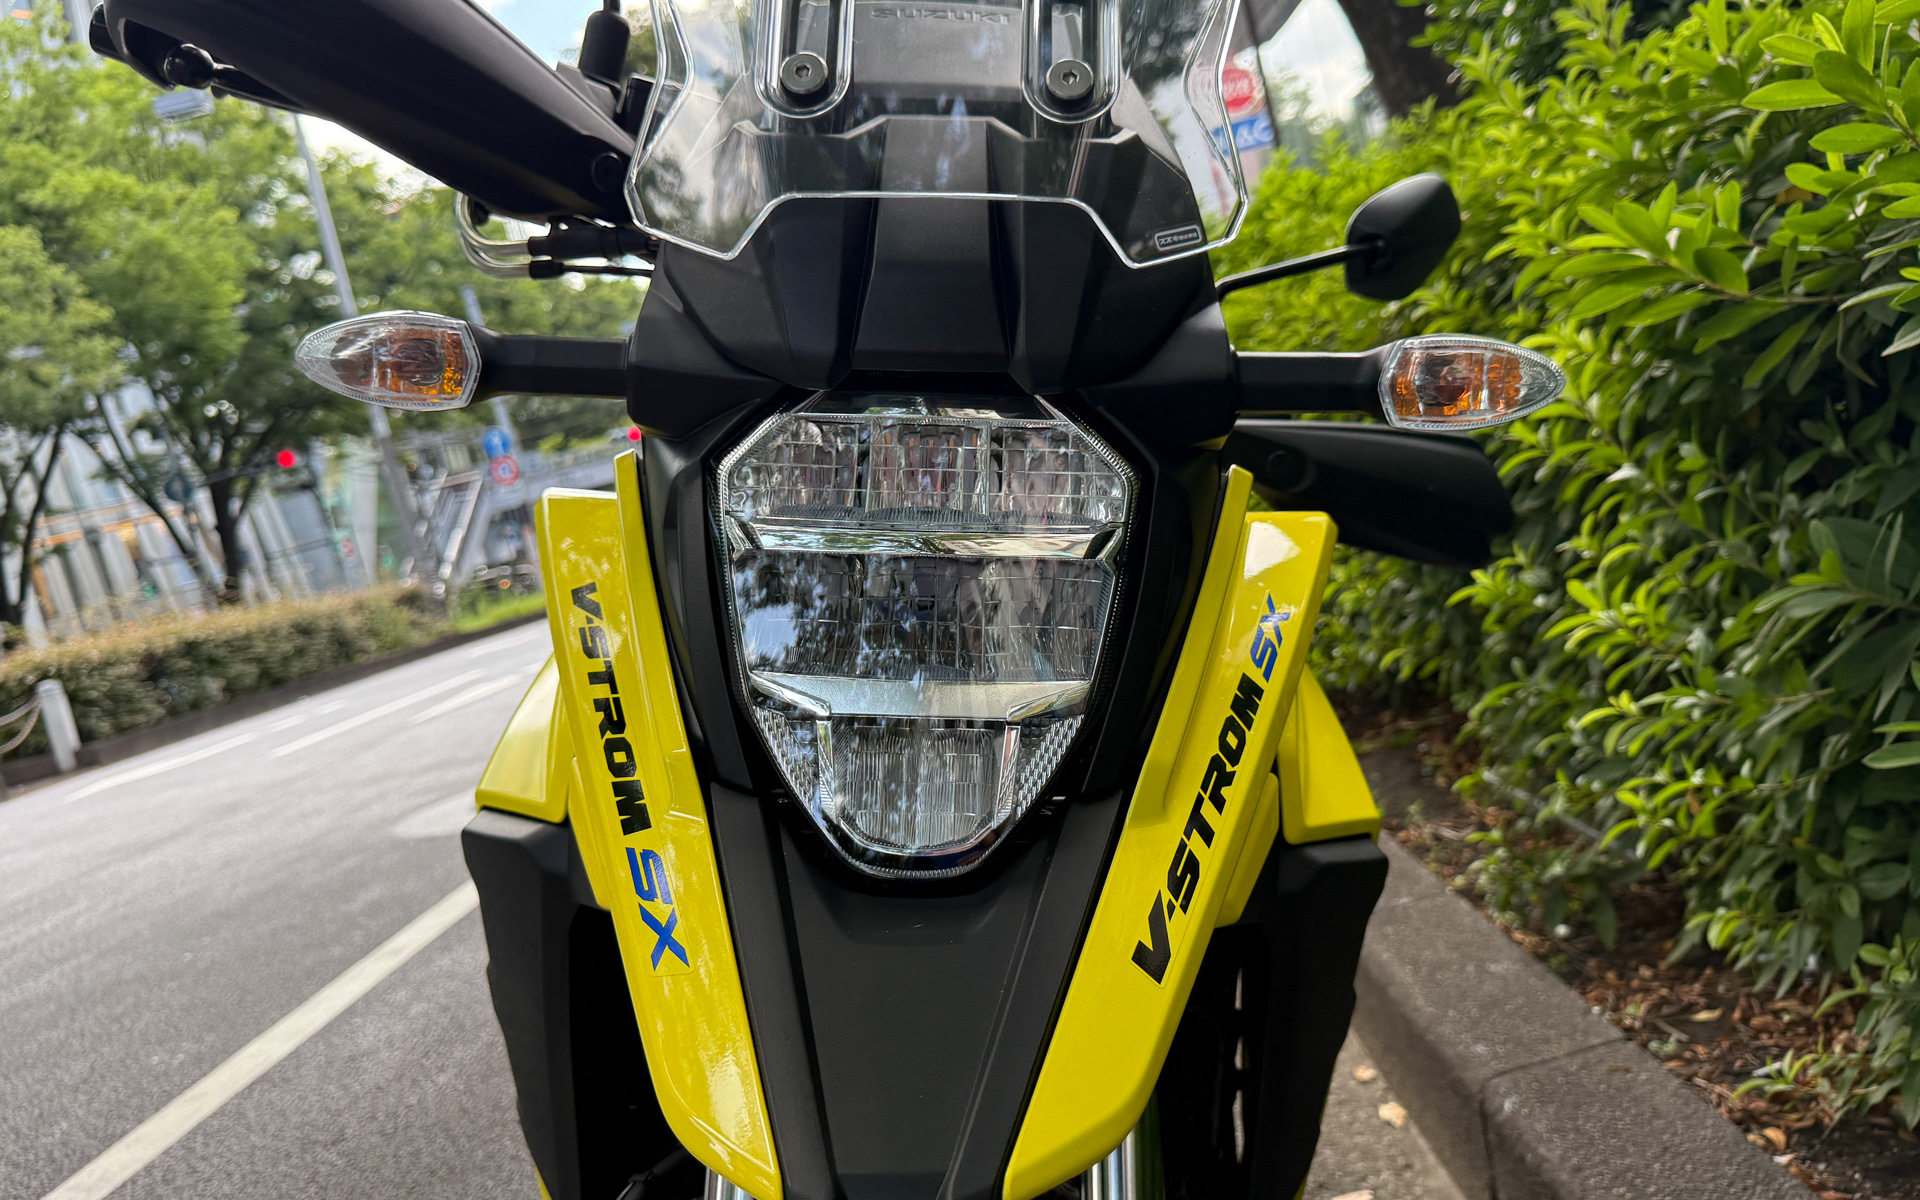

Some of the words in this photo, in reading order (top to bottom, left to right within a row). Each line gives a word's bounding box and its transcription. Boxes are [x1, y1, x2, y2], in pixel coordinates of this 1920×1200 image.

[871, 9, 1009, 24] SUZUKI
[571, 582, 652, 836] V-STROM
[625, 847, 690, 971] SX
[1131, 672, 1264, 984] V-STROM
[1250, 593, 1290, 682] SX
